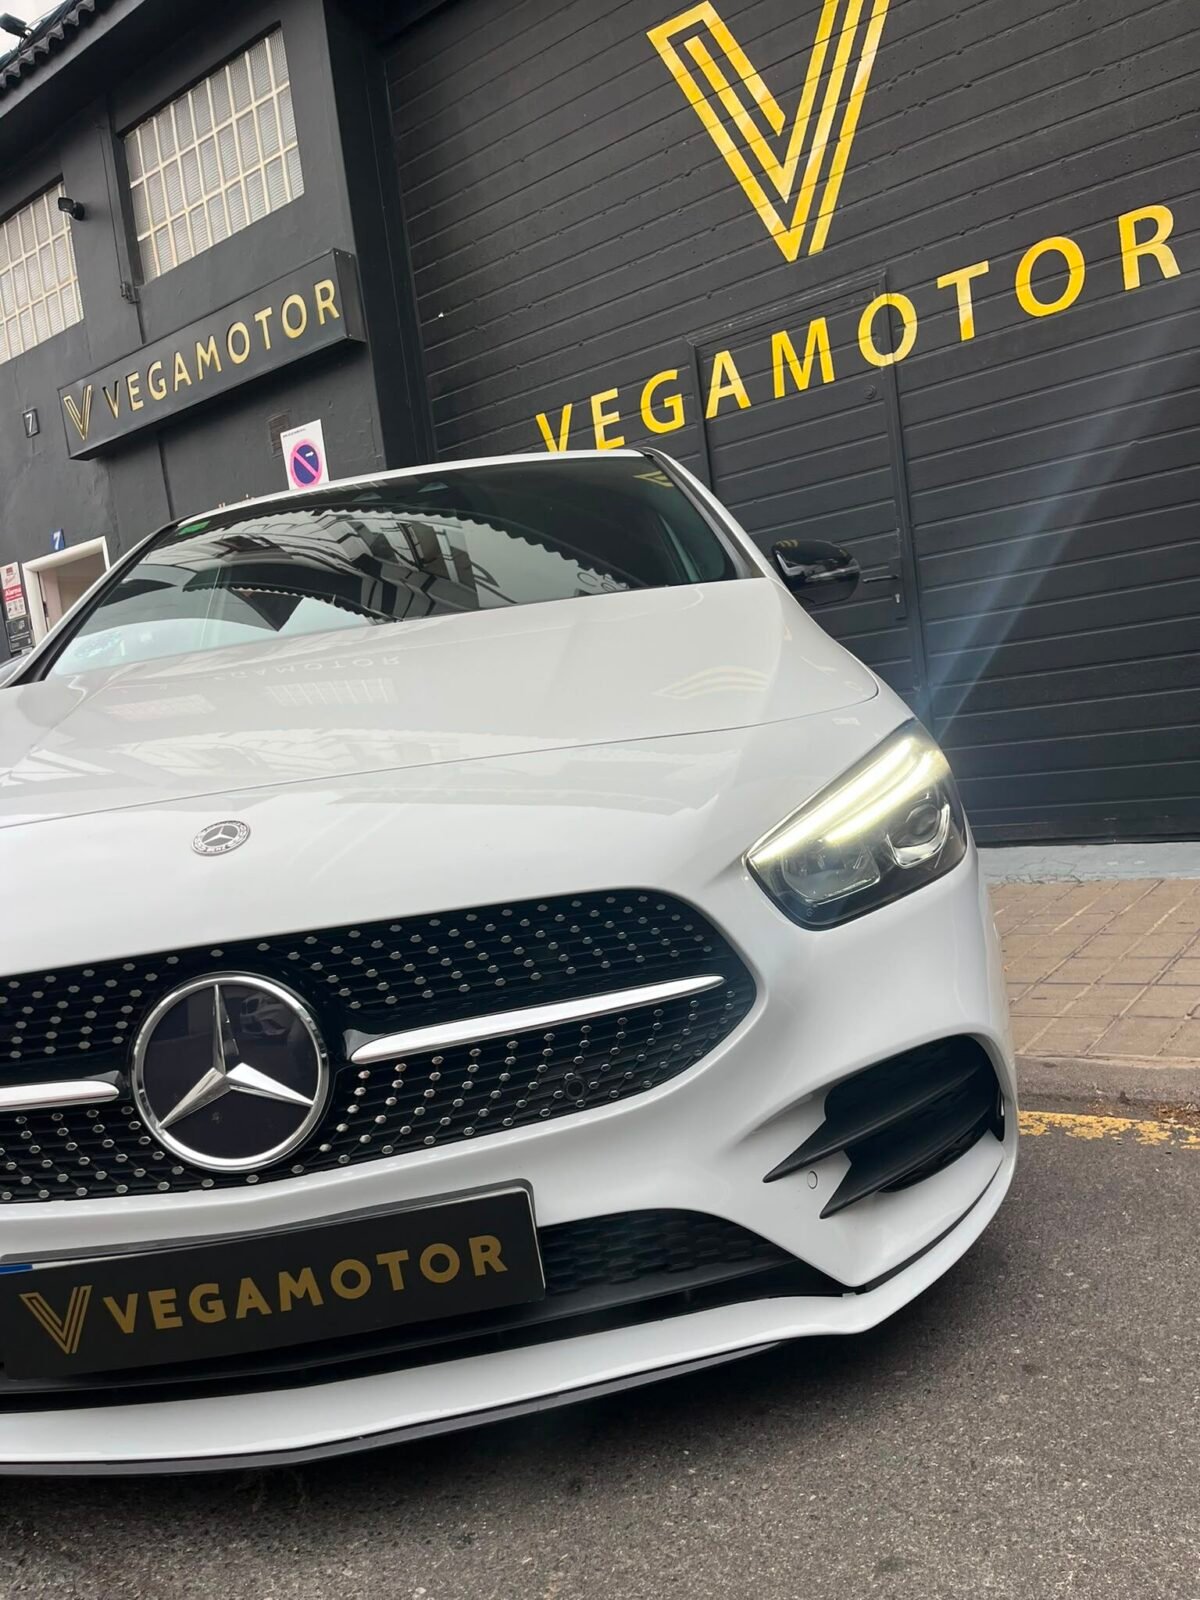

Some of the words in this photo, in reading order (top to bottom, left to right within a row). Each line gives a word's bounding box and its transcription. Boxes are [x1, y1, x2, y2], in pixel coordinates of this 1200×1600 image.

[102, 279, 340, 419] VEGAMOTOR
[535, 204, 1181, 452] VEGAMOTOR
[53, 530, 61, 550] 7
[103, 1234, 508, 1334] VEGAMOTOR
